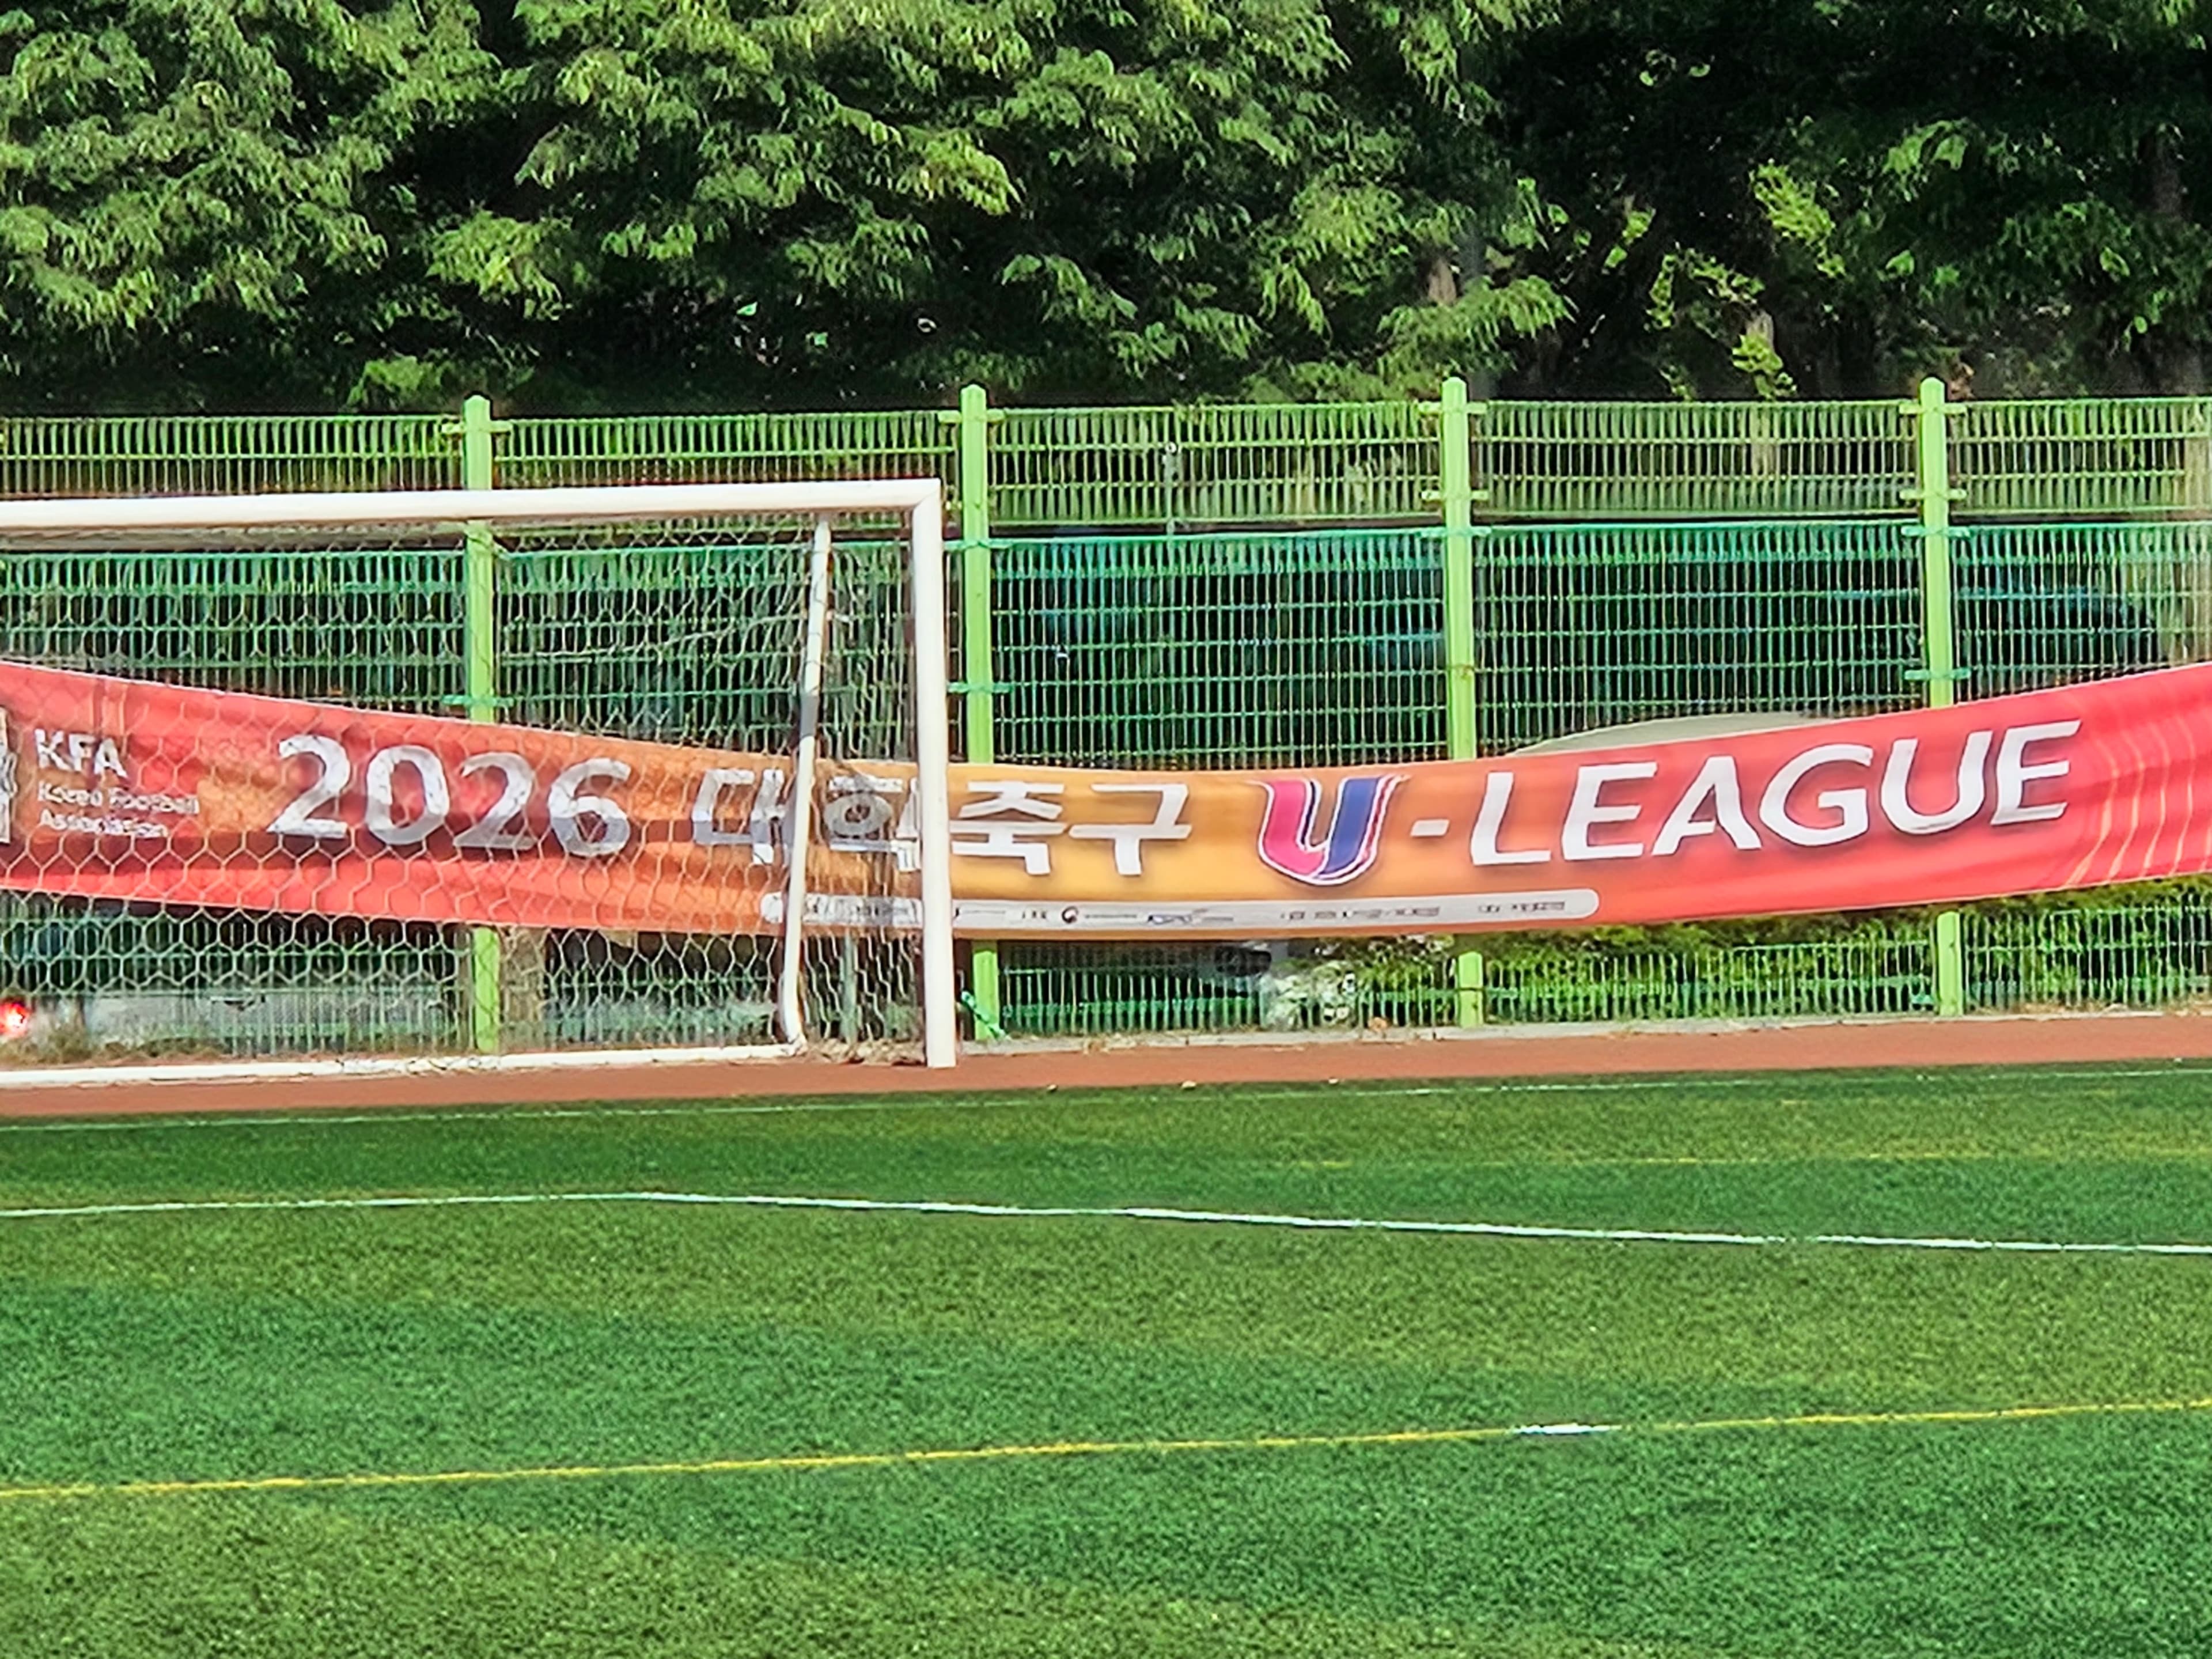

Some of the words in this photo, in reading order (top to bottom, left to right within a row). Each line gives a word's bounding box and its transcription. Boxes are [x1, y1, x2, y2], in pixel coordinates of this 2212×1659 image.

[34, 729, 128, 778] KFA
[267, 734, 631, 857] 2026
[692, 769, 1192, 876] 대학축구
